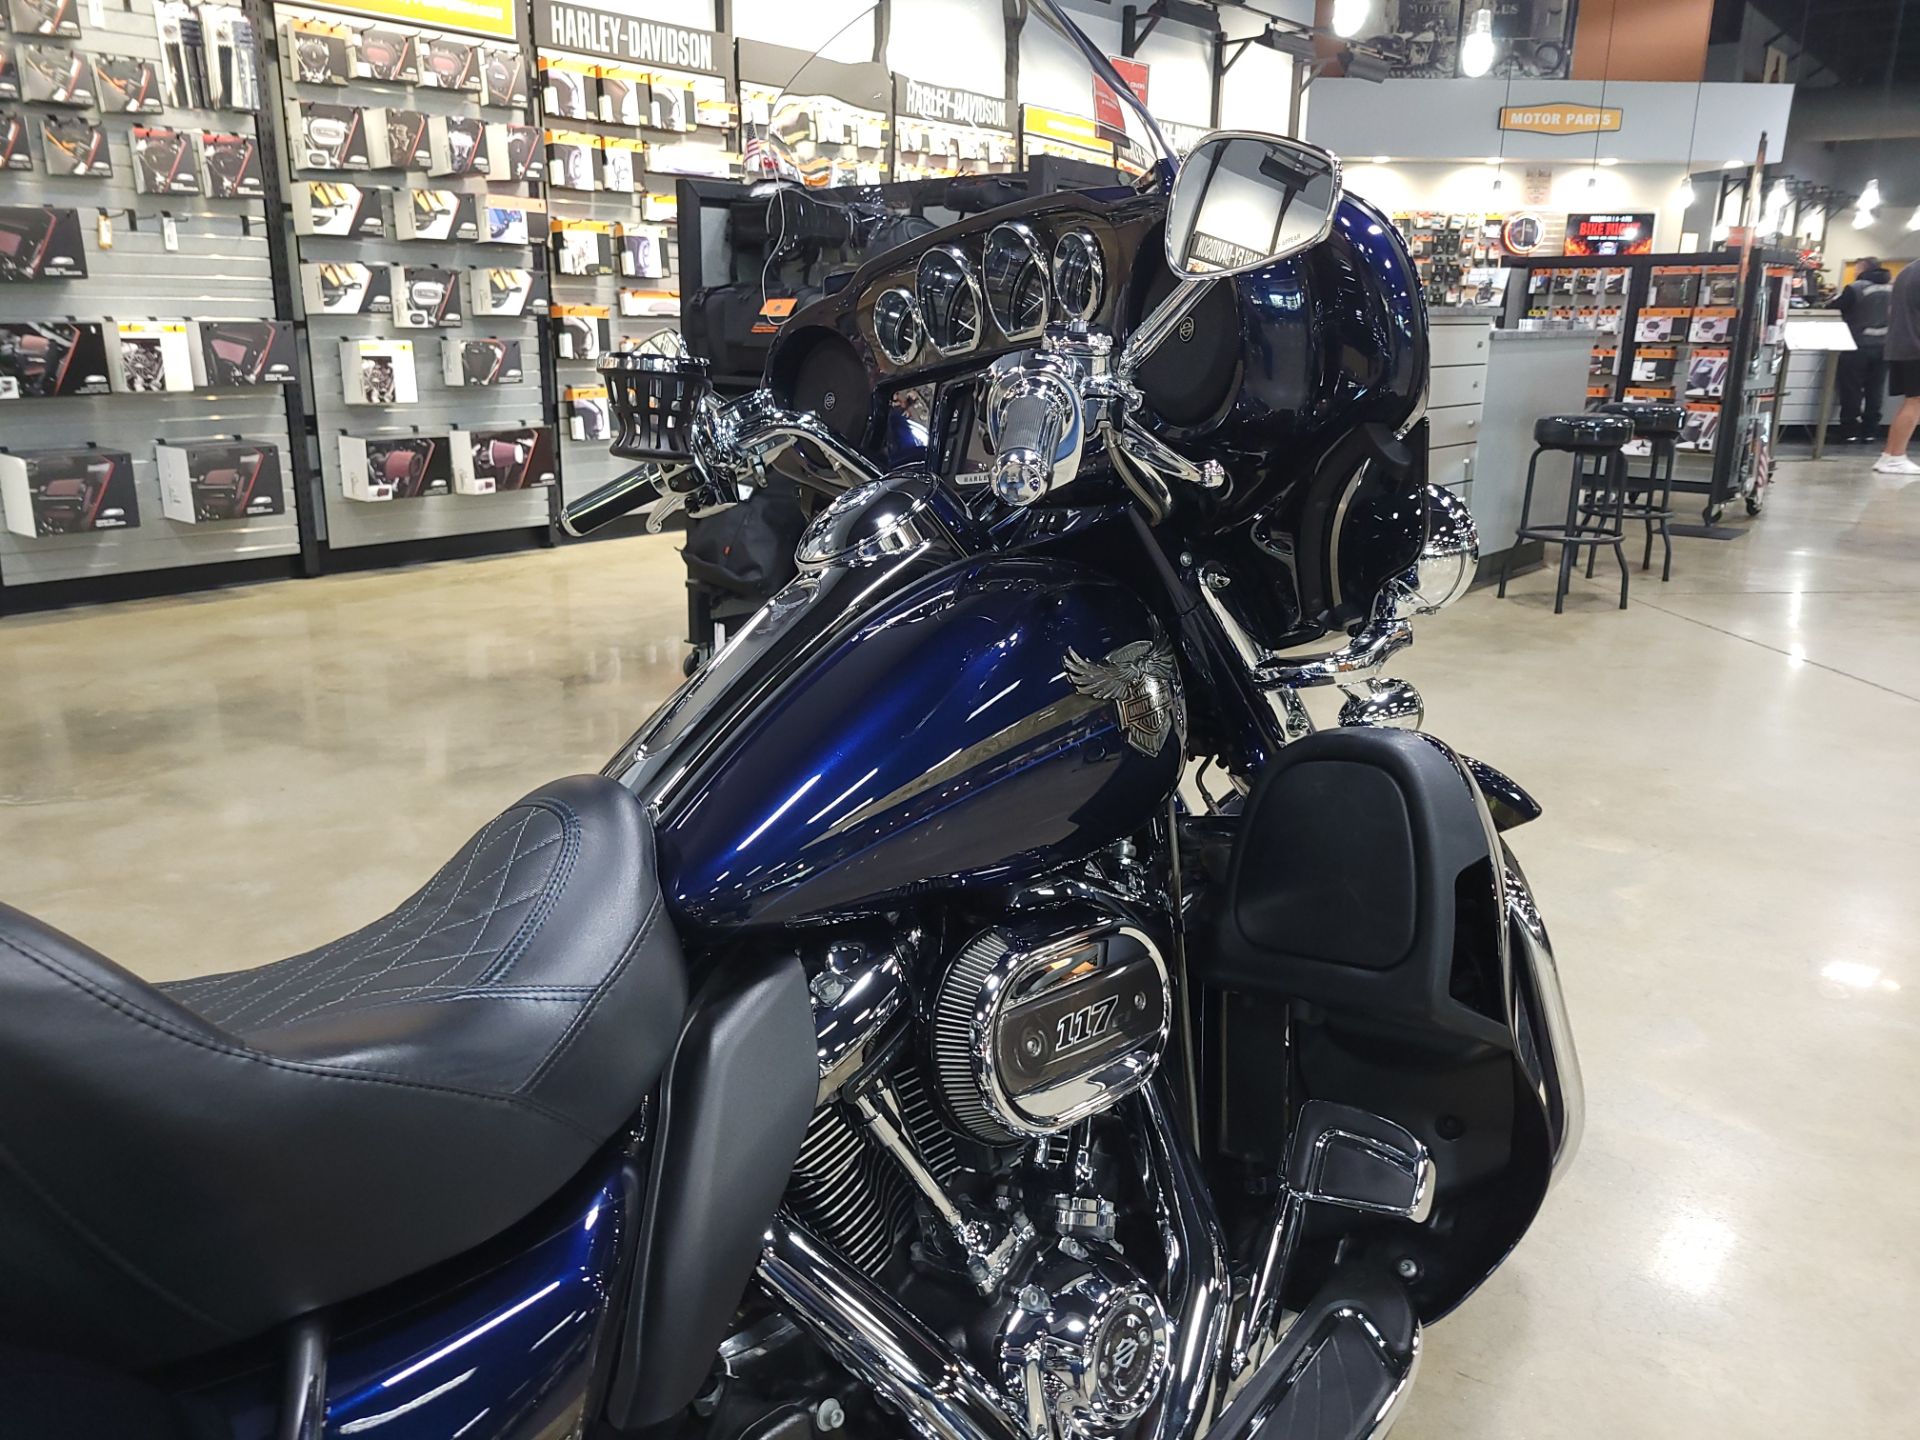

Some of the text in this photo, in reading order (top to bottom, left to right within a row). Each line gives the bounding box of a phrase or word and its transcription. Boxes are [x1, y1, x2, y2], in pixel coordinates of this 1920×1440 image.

[551, 5, 713, 71] HARLEY-DAVIDSON
[905, 81, 1007, 127] HARLEY-DAVIDSON
[1511, 113, 1611, 126] MOTOR PARTS
[1579, 222, 1604, 236] BIKE
[1056, 995, 1118, 1051] 117
